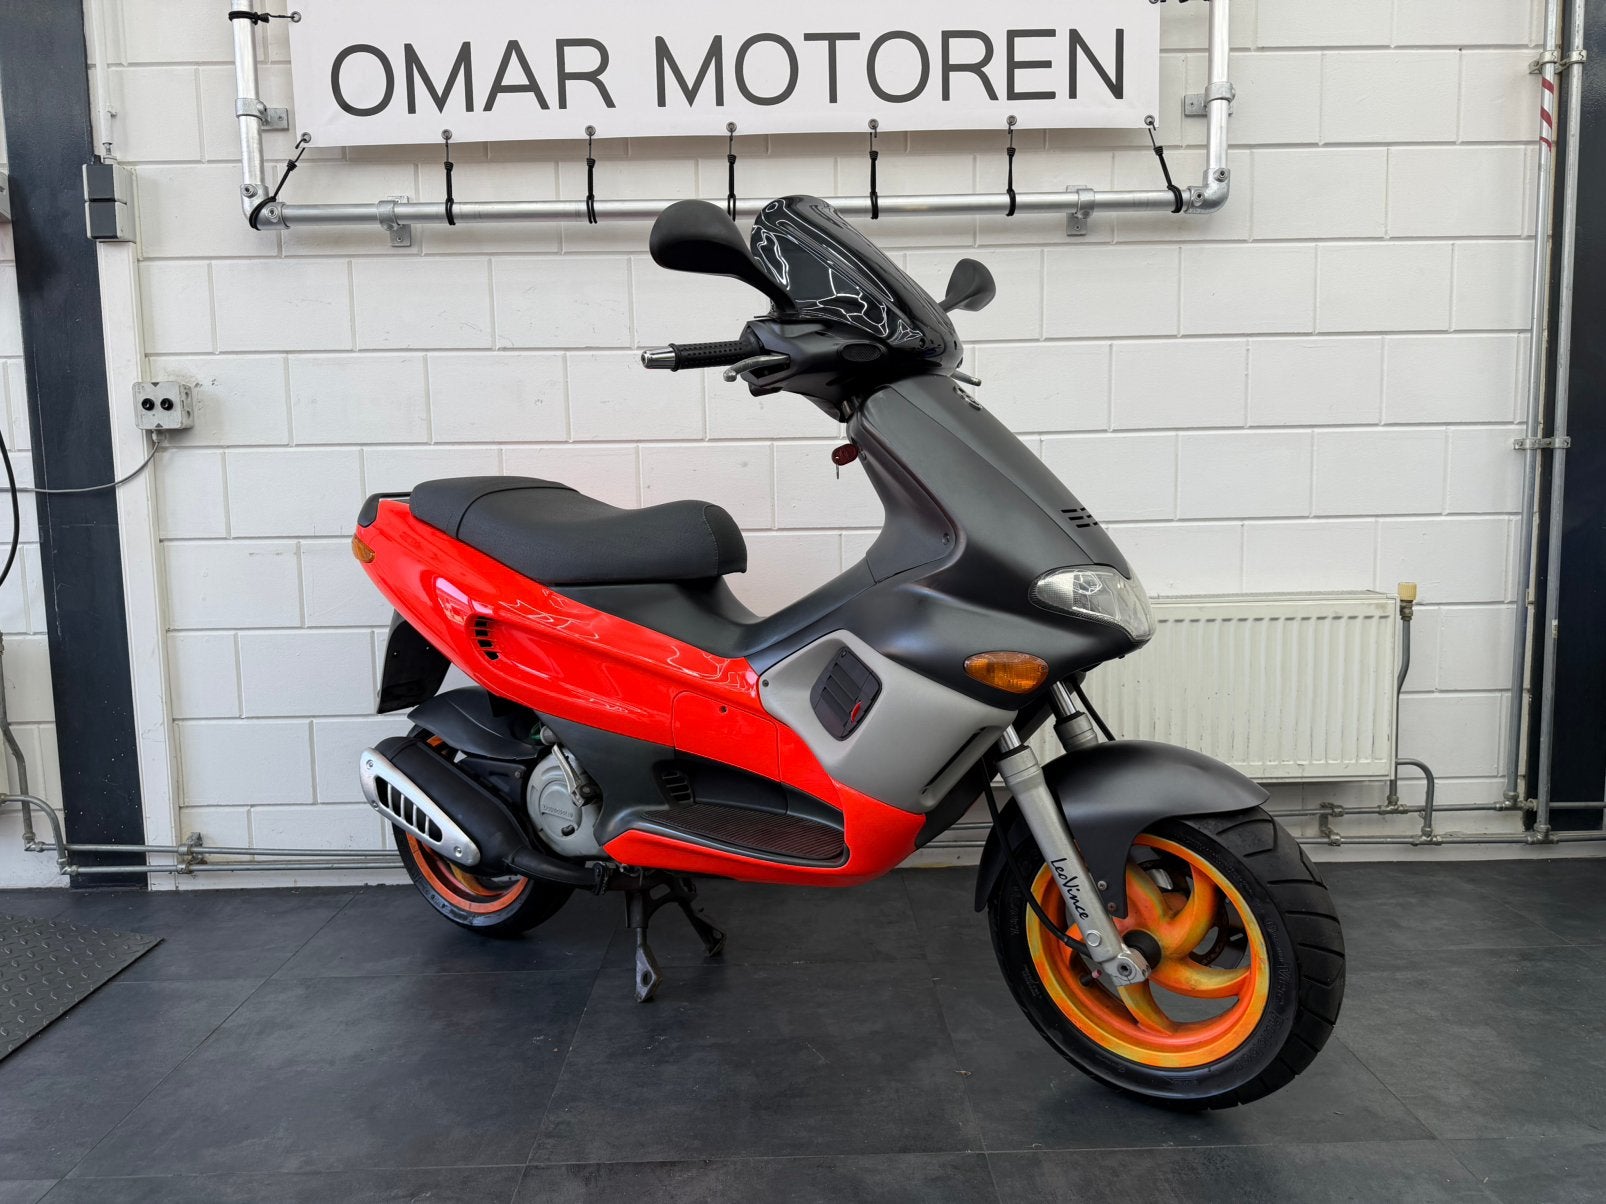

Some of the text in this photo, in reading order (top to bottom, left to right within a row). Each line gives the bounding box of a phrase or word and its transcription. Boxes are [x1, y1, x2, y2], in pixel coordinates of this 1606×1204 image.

[331, 28, 1125, 117] OMAR MOTOREN
[1050, 857, 1089, 921] LeoVince
